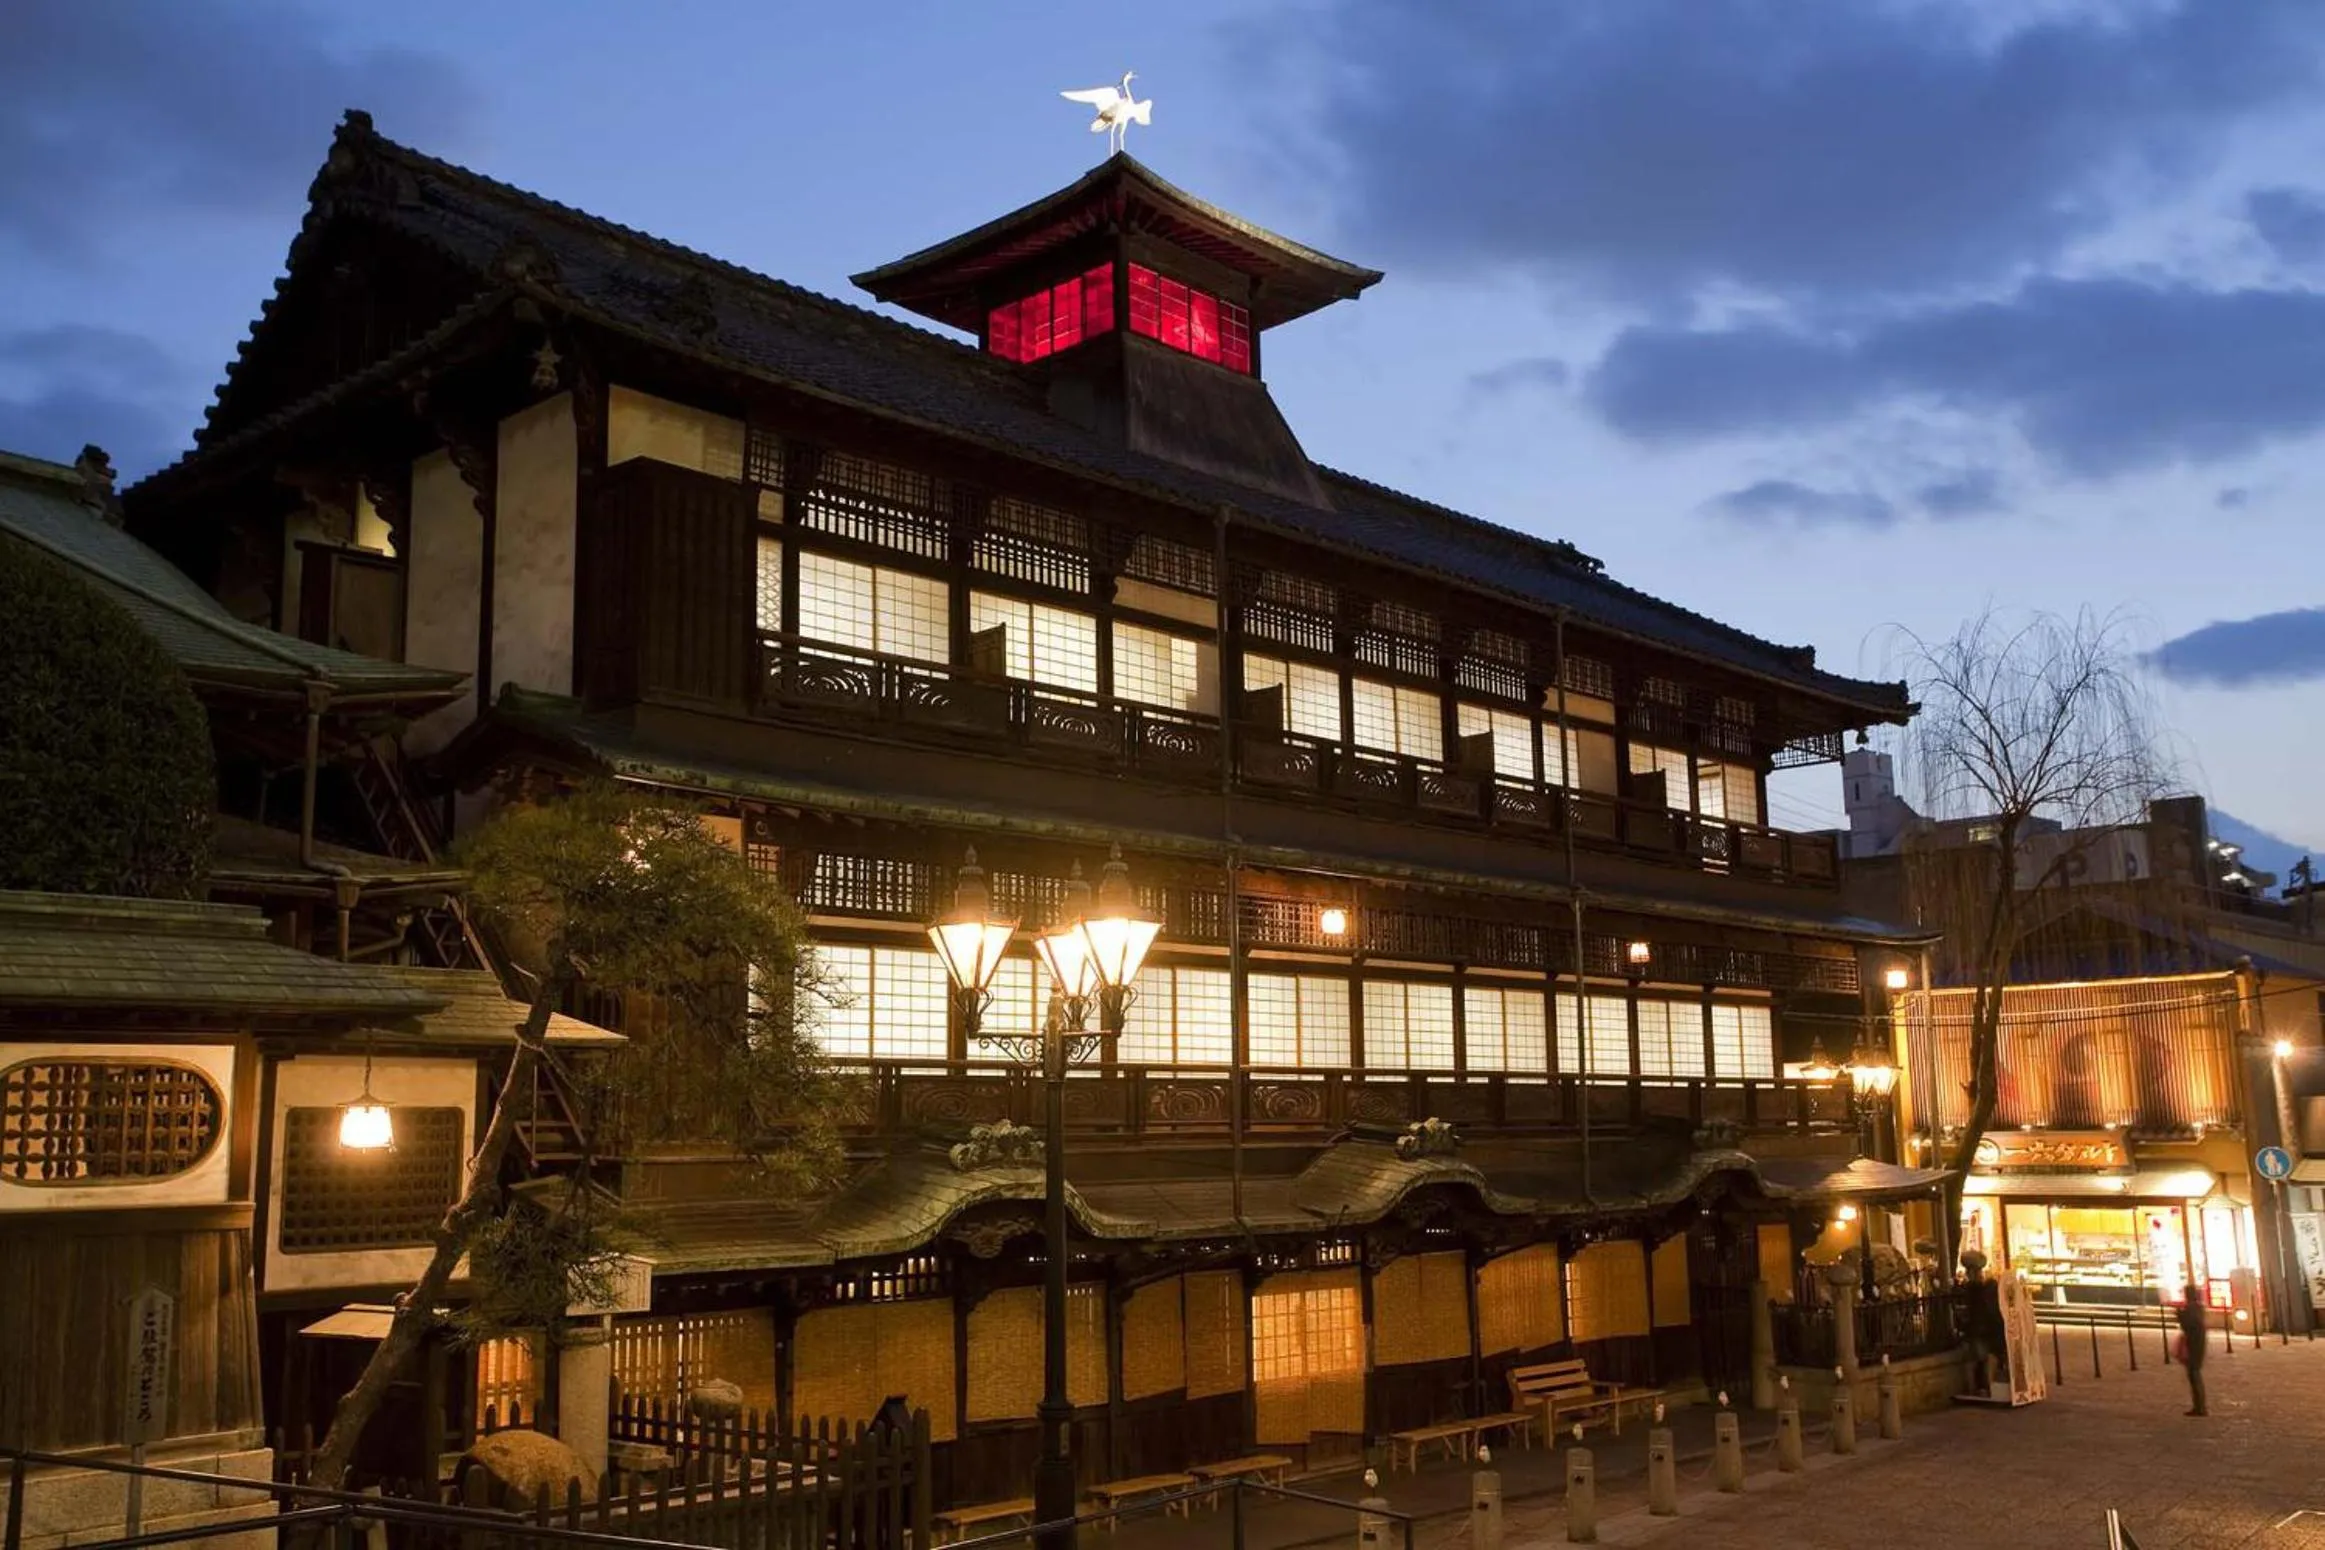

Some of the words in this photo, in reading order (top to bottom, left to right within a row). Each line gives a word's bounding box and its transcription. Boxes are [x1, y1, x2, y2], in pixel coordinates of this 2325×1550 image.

[2004, 1139, 2118, 1164] 一六タルト
